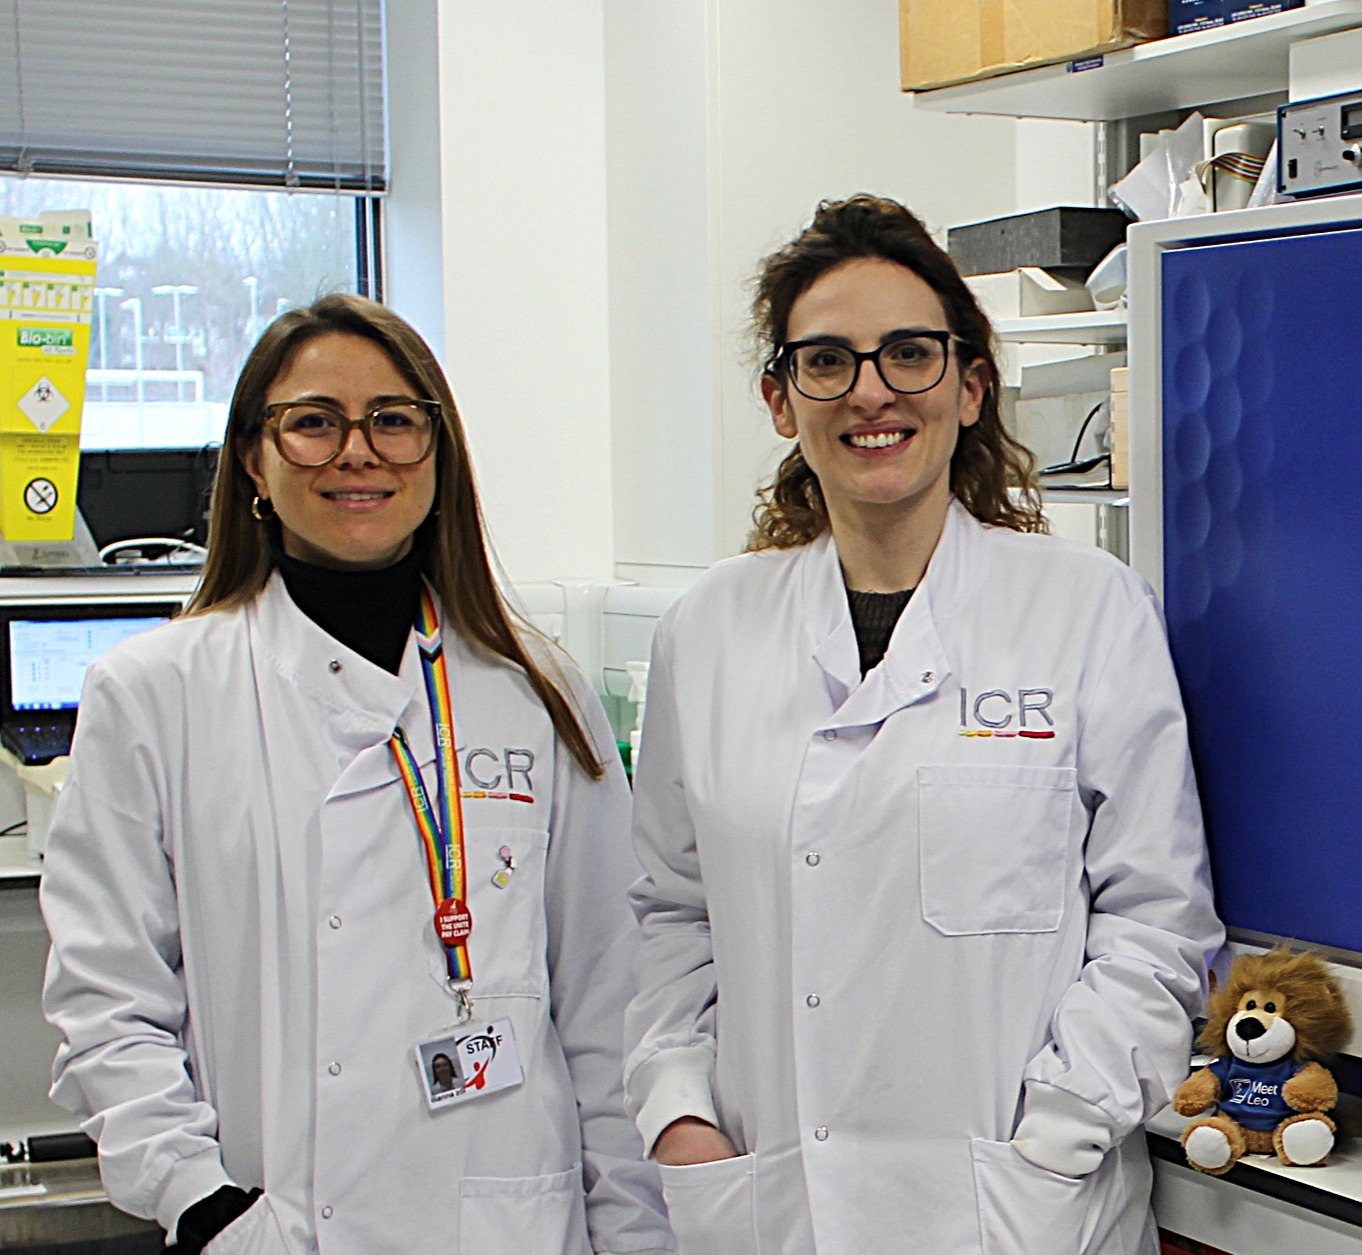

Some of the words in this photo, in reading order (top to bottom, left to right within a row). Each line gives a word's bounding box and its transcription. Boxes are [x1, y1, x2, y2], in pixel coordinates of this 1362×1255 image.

[960, 687, 1054, 728] ICR
[437, 723, 451, 748] ICR
[458, 747, 534, 791] CR
[446, 843, 462, 869] ICR
[443, 913, 469, 923] SUPPORT
[1247, 1093, 1269, 1107] Leo
[1251, 1081, 1278, 1095] Meet
